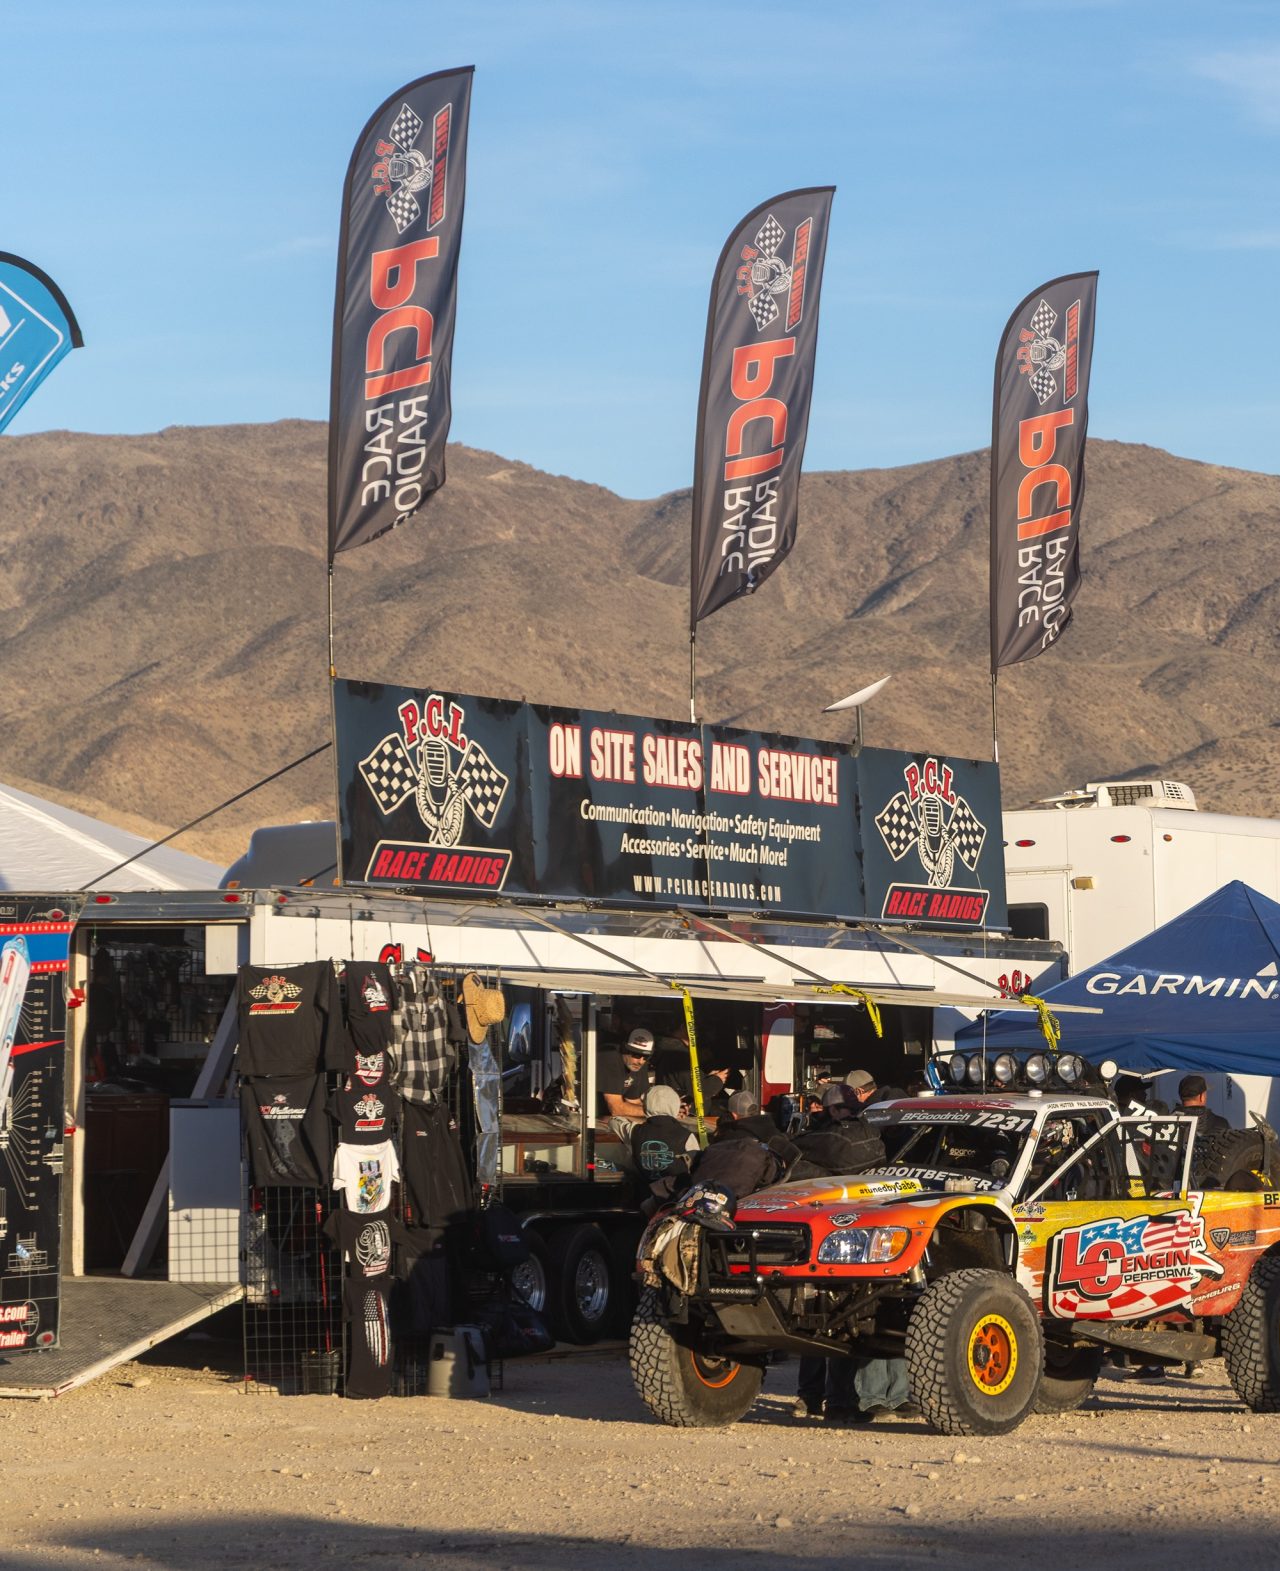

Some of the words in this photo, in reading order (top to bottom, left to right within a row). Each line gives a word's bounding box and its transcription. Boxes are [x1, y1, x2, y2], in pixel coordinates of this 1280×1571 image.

[0, 362, 25, 398] KS
[398, 694, 467, 751] P.C.I.
[550, 722, 583, 778] ON
[590, 727, 636, 784] SITE
[643, 733, 702, 791] SALES
[710, 742, 751, 795] AND
[758, 747, 839, 807] SERVICE!
[903, 758, 957, 807] P.C.I.
[769, 818, 821, 843] Equipment
[373, 849, 429, 879] RACE
[428, 854, 505, 885] RADIOS
[759, 845, 788, 867] More!
[633, 875, 782, 902] WWW.PCIRACERADIOS.COM
[887, 891, 928, 916] RACE
[928, 893, 984, 920] RADIOS
[901, 1112, 971, 1121] BFGoodrich
[970, 1113, 1033, 1132] 7231
[859, 1180, 918, 1194] #tunedbyGabe
[1059, 1232, 1125, 1295] LC
